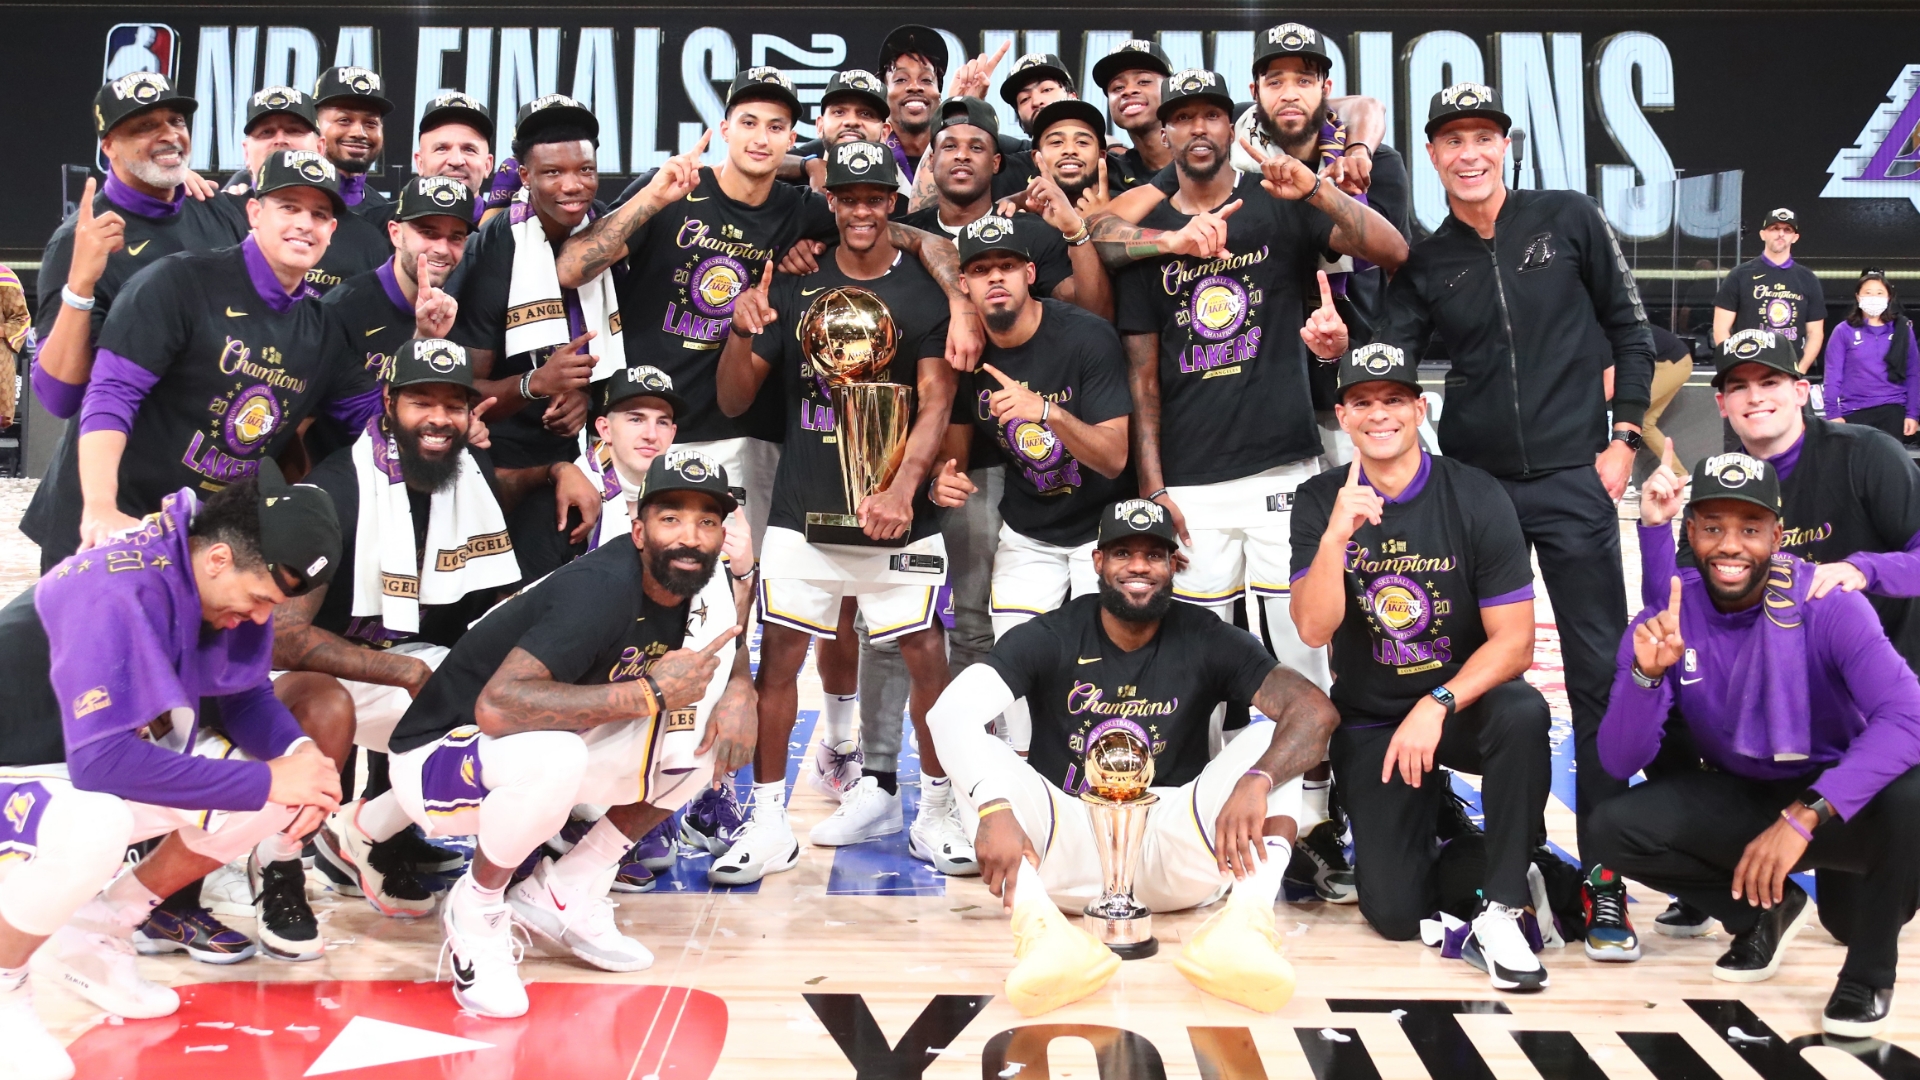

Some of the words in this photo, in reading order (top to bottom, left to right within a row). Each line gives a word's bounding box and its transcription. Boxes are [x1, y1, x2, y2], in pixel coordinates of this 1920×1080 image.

[1268, 23, 1316, 45] CHAMPIONS
[1441, 83, 1492, 106] CHAMPIONS
[837, 142, 884, 165] CHAMPIONS
[676, 216, 777, 262] Champions
[967, 215, 1014, 240] CHAMPIONS
[674, 268, 689, 285] 20
[1161, 244, 1270, 296] Champions
[1249, 289, 1262, 305] 20
[662, 301, 732, 342] LAKE
[1175, 309, 1190, 326] 20
[1179, 326, 1262, 374] LAKERS
[1351, 343, 1405, 367] CHAMPIONS
[1723, 329, 1776, 356] CHAMPIONS
[219, 335, 307, 394] Champions
[664, 450, 720, 479] CHAMPIONS
[1704, 452, 1765, 482] CHAMPIONS
[1114, 499, 1164, 524] CHAMPIONS
[1344, 540, 1457, 576] Champions
[1379, 599, 1419, 615] LAKERS
[1432, 600, 1451, 616] 20
[1067, 680, 1179, 719] Champions
[1069, 735, 1084, 752] 20
